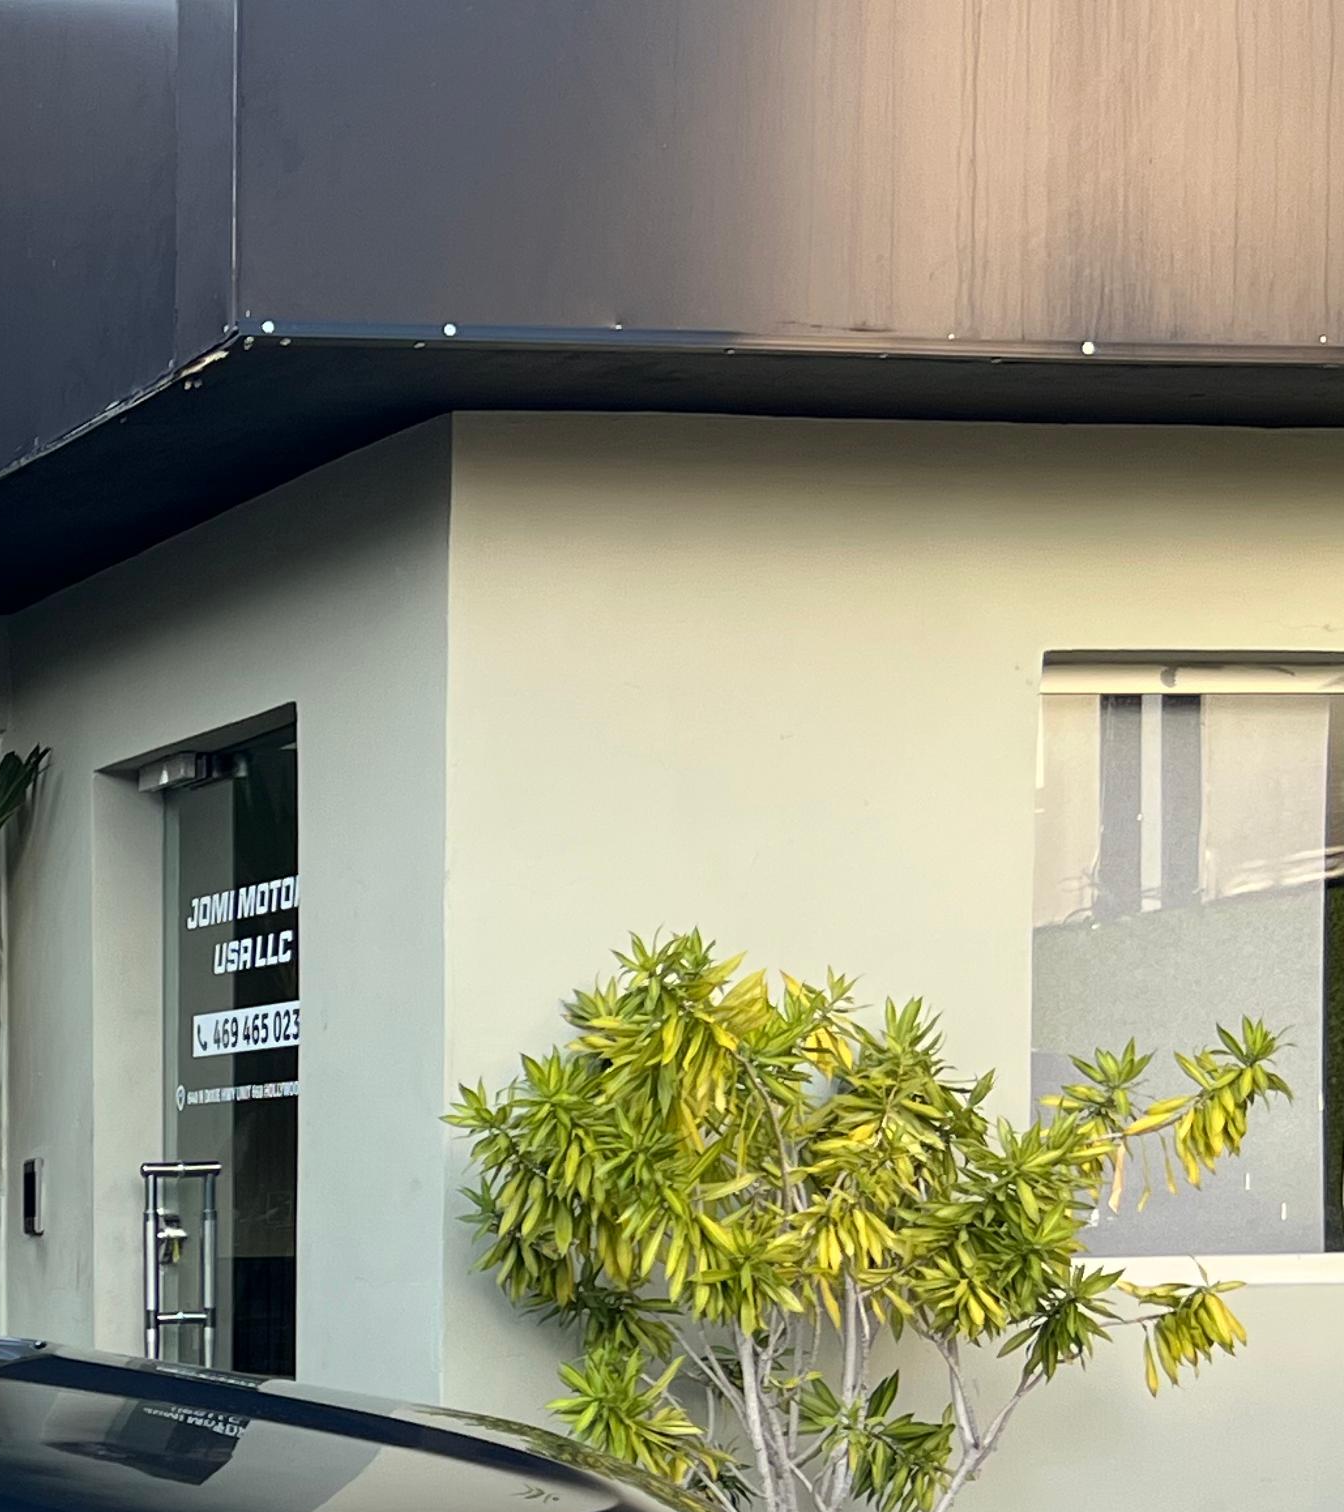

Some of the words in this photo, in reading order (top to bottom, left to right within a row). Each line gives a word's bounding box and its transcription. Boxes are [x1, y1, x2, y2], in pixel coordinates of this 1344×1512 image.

[187, 890, 235, 930] JOMI
[214, 938, 253, 974] USA
[255, 930, 293, 968] LLC
[213, 1017, 239, 1050] 469
[243, 1013, 269, 1046] 465
